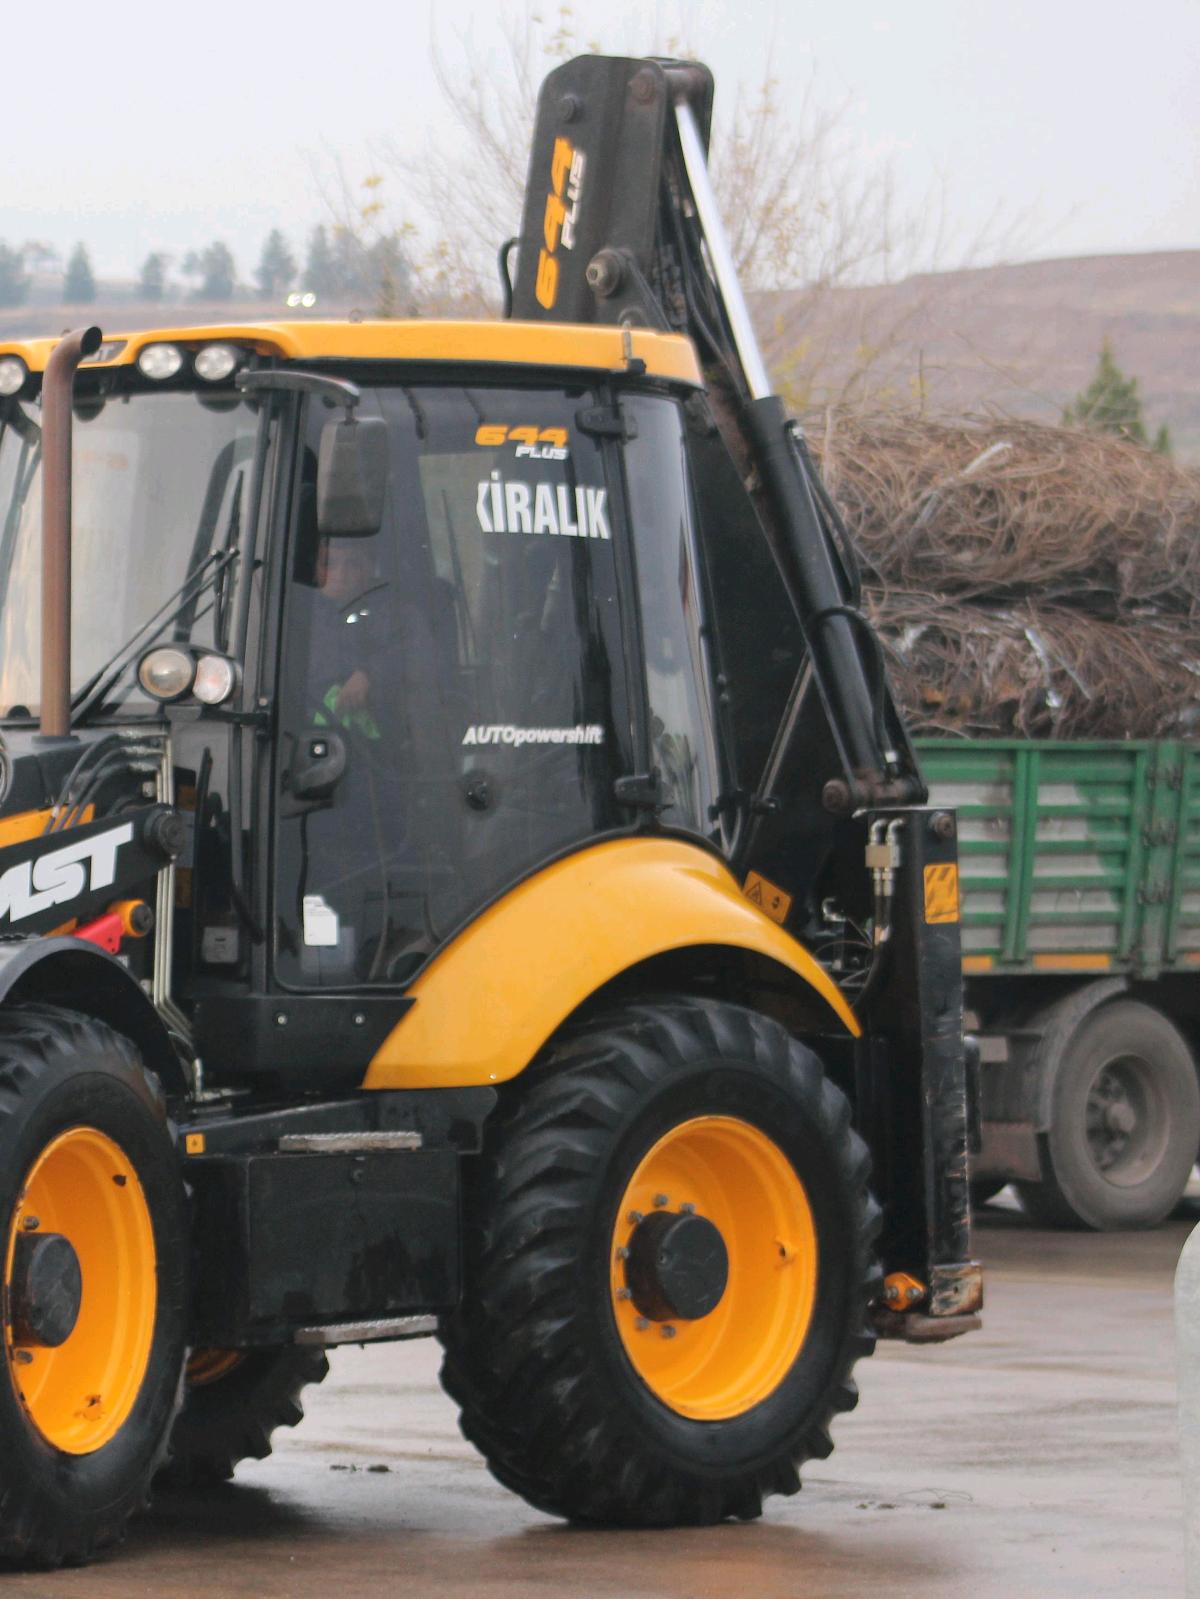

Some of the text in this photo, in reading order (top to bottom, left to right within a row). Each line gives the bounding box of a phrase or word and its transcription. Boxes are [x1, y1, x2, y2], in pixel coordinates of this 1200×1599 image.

[561, 149, 585, 249] PLUS
[515, 446, 568, 460] PLUS
[462, 725, 604, 747] AUTOpowershift
